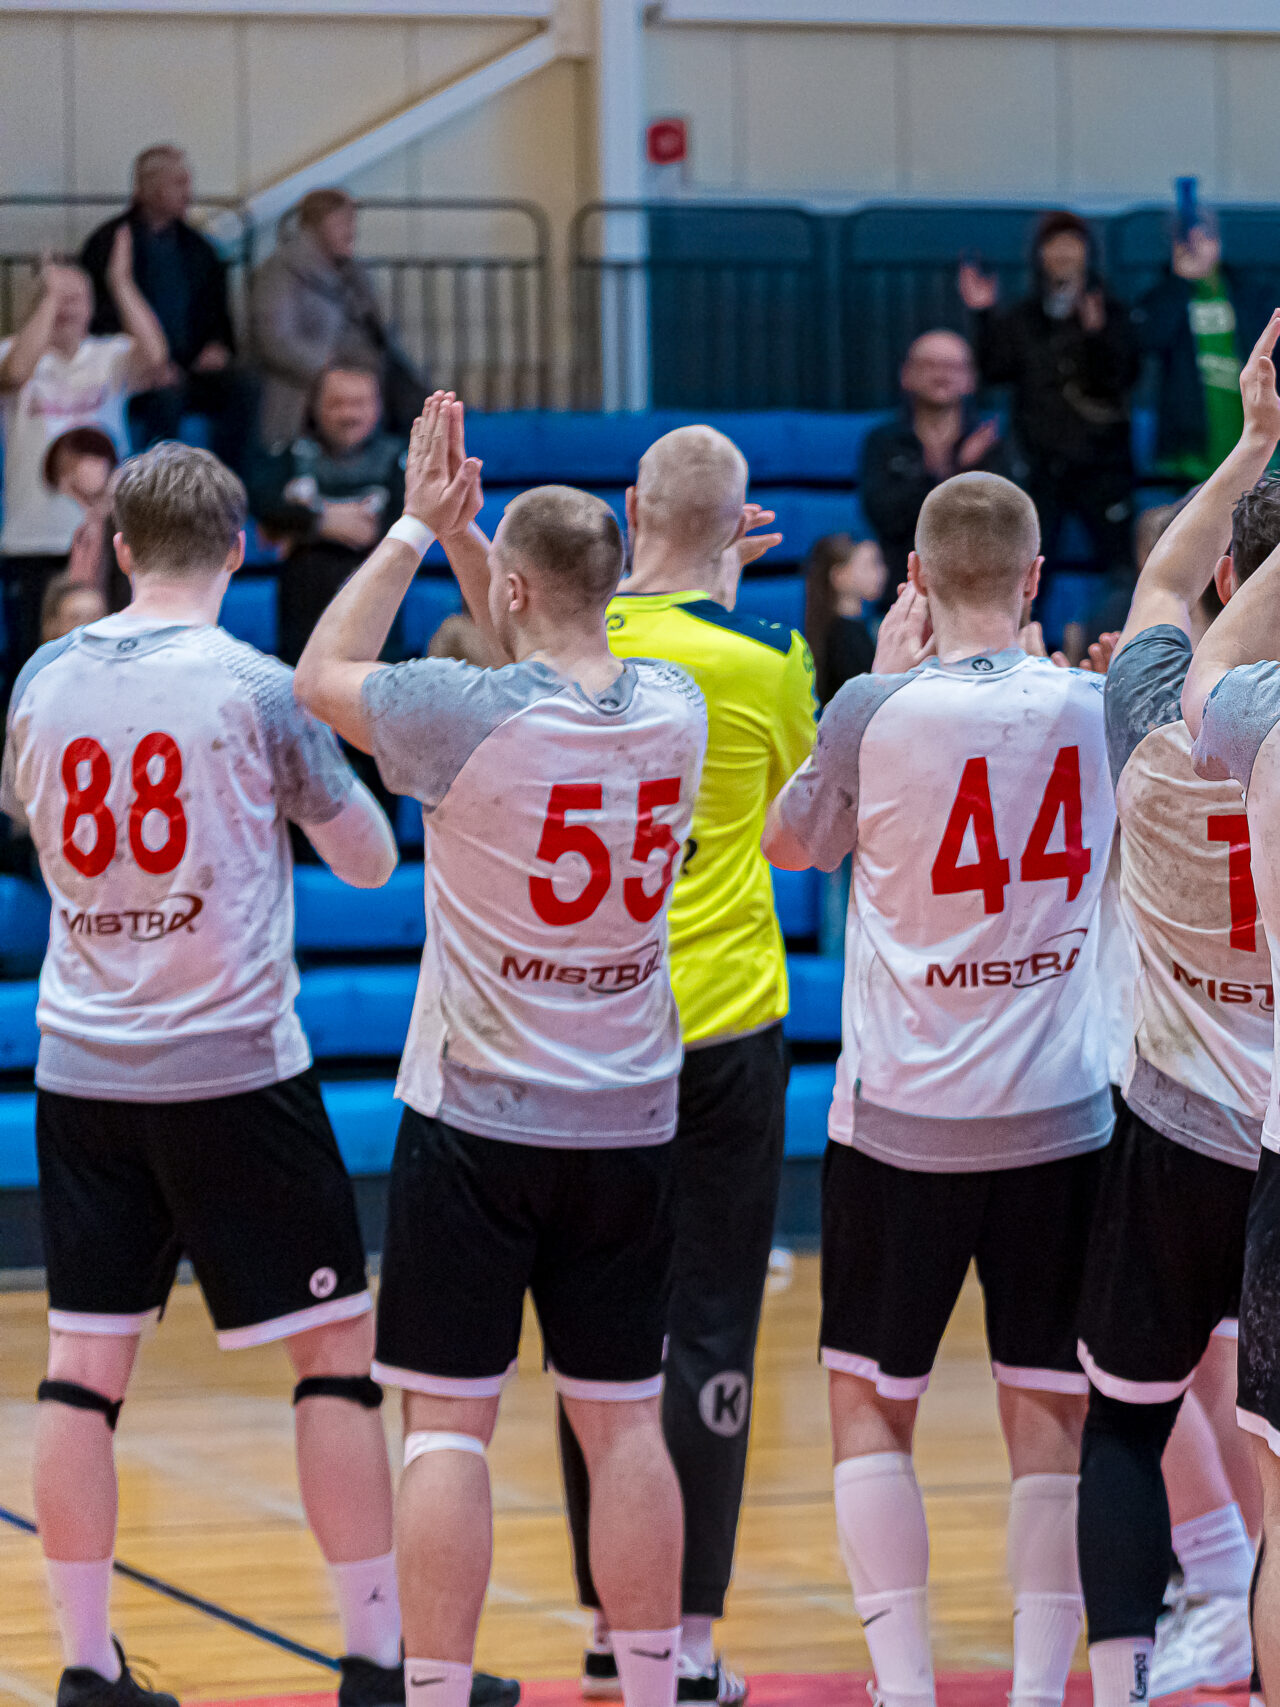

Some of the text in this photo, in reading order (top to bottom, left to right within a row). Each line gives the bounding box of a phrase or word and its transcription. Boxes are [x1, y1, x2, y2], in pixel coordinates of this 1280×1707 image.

[61, 732, 187, 877] 88
[529, 777, 680, 926] 55
[931, 746, 1091, 914] 44
[61, 905, 200, 938] MISTRA
[1172, 960, 1275, 1007] MIST
